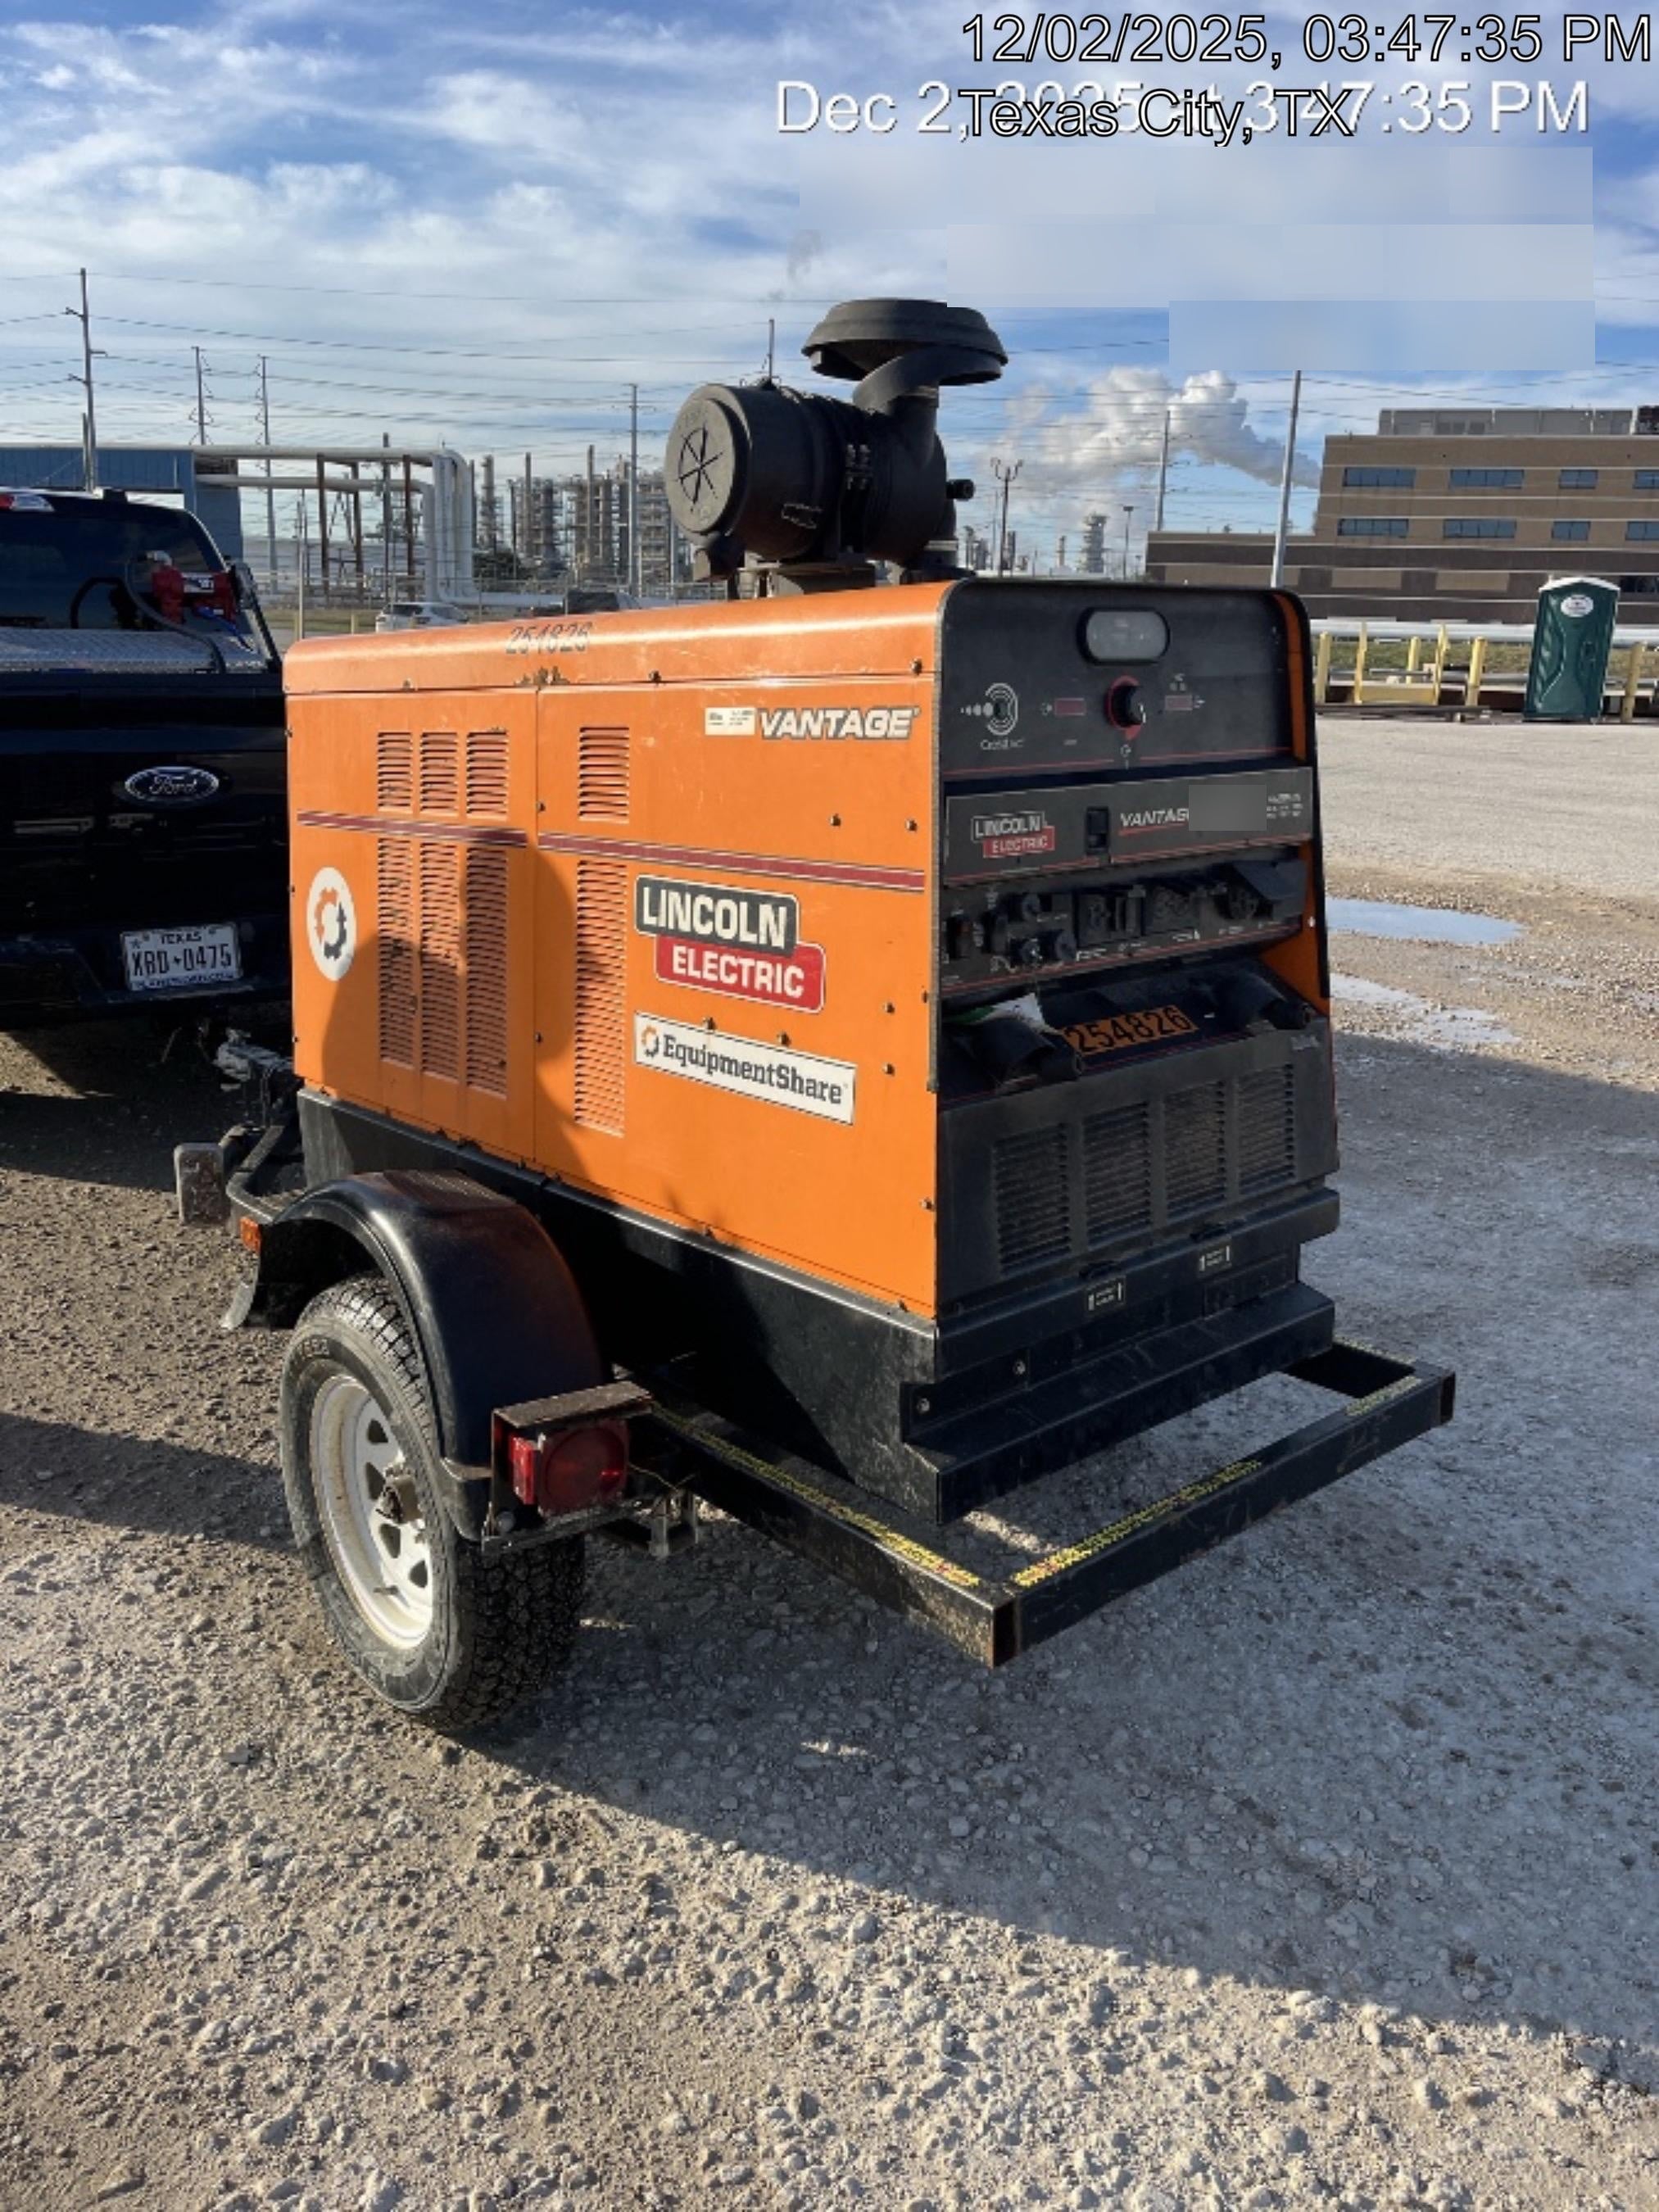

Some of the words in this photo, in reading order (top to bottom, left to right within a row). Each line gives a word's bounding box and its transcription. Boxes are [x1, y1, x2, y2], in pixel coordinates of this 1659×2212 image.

[759, 707, 916, 741] VANTAGE
[974, 814, 1042, 839] LINCOLN
[1119, 807, 1190, 827] VANTAG
[161, 931, 202, 945] TEXAS
[642, 886, 788, 950] LINCOLN
[672, 944, 805, 999] ELECTRIC
[1063, 1006, 1192, 1052] 254826
[662, 1033, 843, 1104] EquipmentShare
